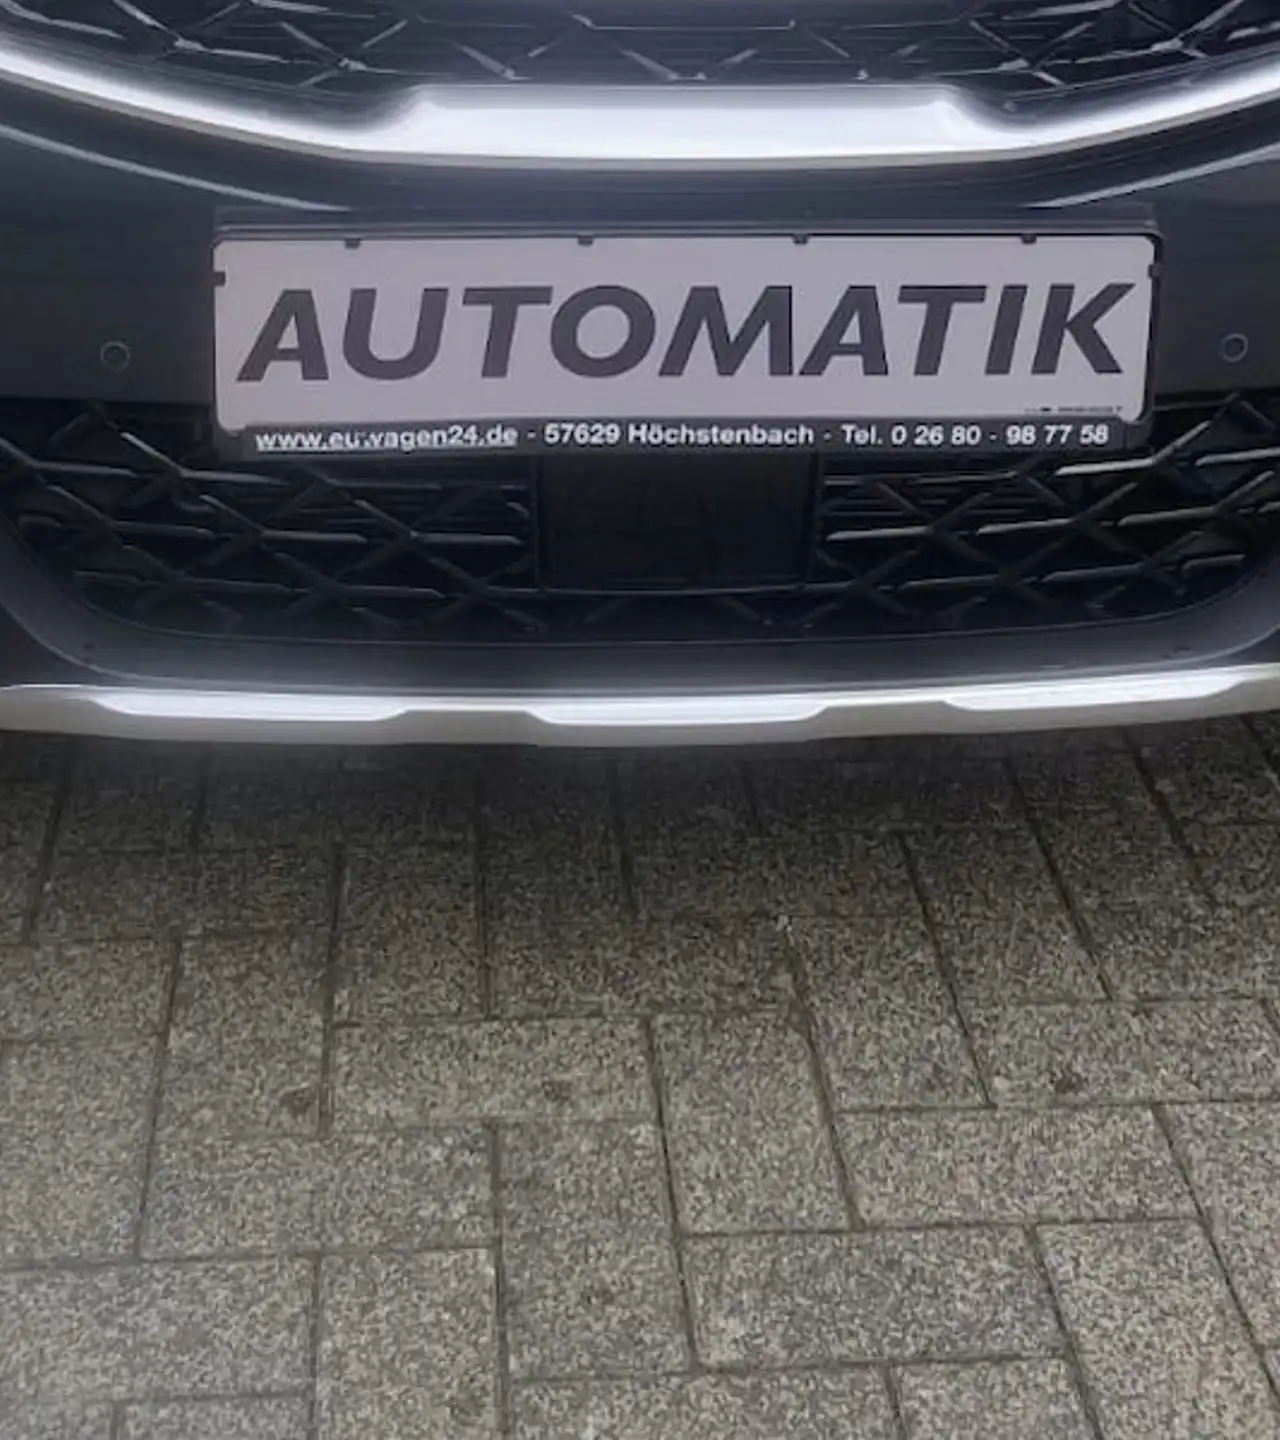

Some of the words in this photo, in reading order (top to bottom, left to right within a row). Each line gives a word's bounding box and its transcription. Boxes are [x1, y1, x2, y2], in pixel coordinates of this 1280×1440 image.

[236, 282, 1135, 381] AUTOMATIK
[543, 423, 621, 446] 57629
[628, 421, 815, 446] Höchstenbach
[840, 423, 884, 445] Tel.
[891, 423, 909, 446] 0
[913, 423, 945, 446] 26
[950, 423, 982, 446] 80
[1004, 423, 1037, 445] 98
[1044, 423, 1071, 445] 77
[1078, 423, 1109, 444] 58
